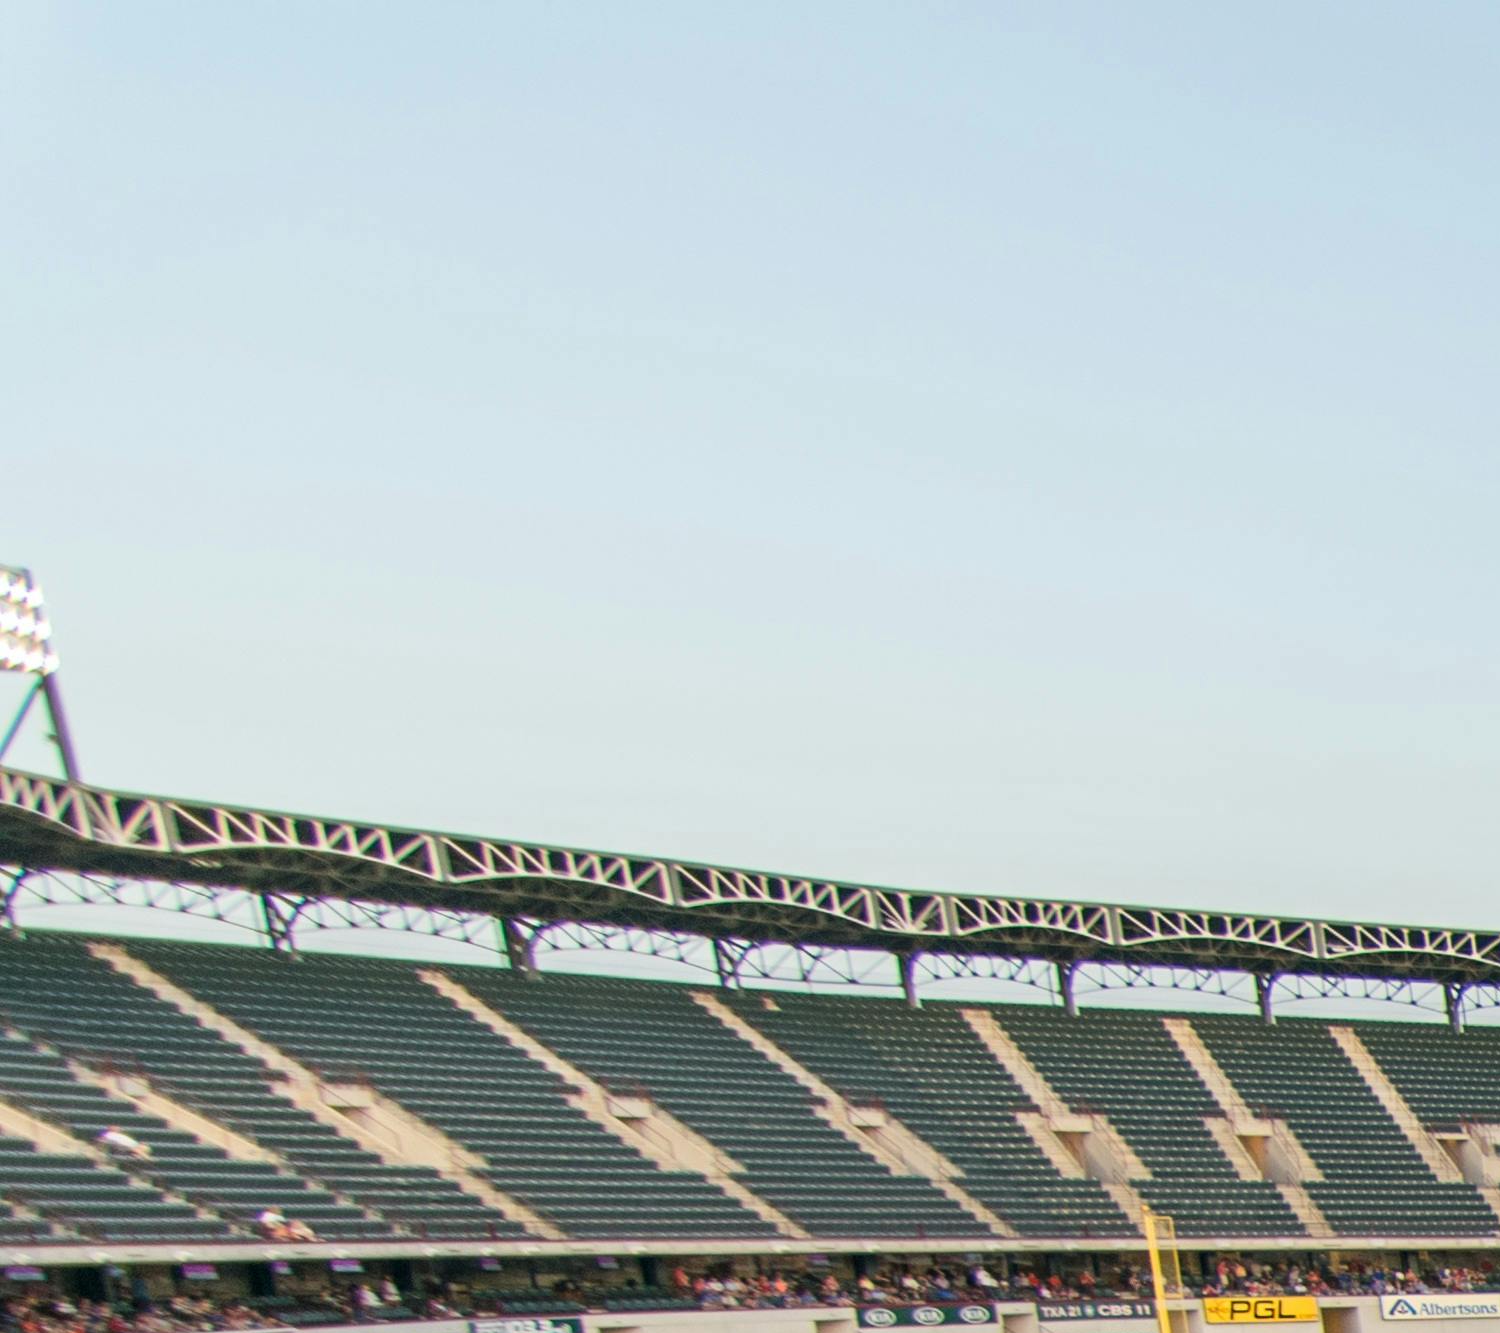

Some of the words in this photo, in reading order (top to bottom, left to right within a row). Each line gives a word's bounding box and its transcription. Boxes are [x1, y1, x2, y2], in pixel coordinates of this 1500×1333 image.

[1040, 1305, 1065, 1318] TXA
[1067, 1305, 1081, 1318] 21
[1099, 1304, 1131, 1317] CBS
[1136, 1304, 1152, 1316] 11
[1230, 1301, 1297, 1320] PGL
[1419, 1301, 1499, 1317] Albertsons
